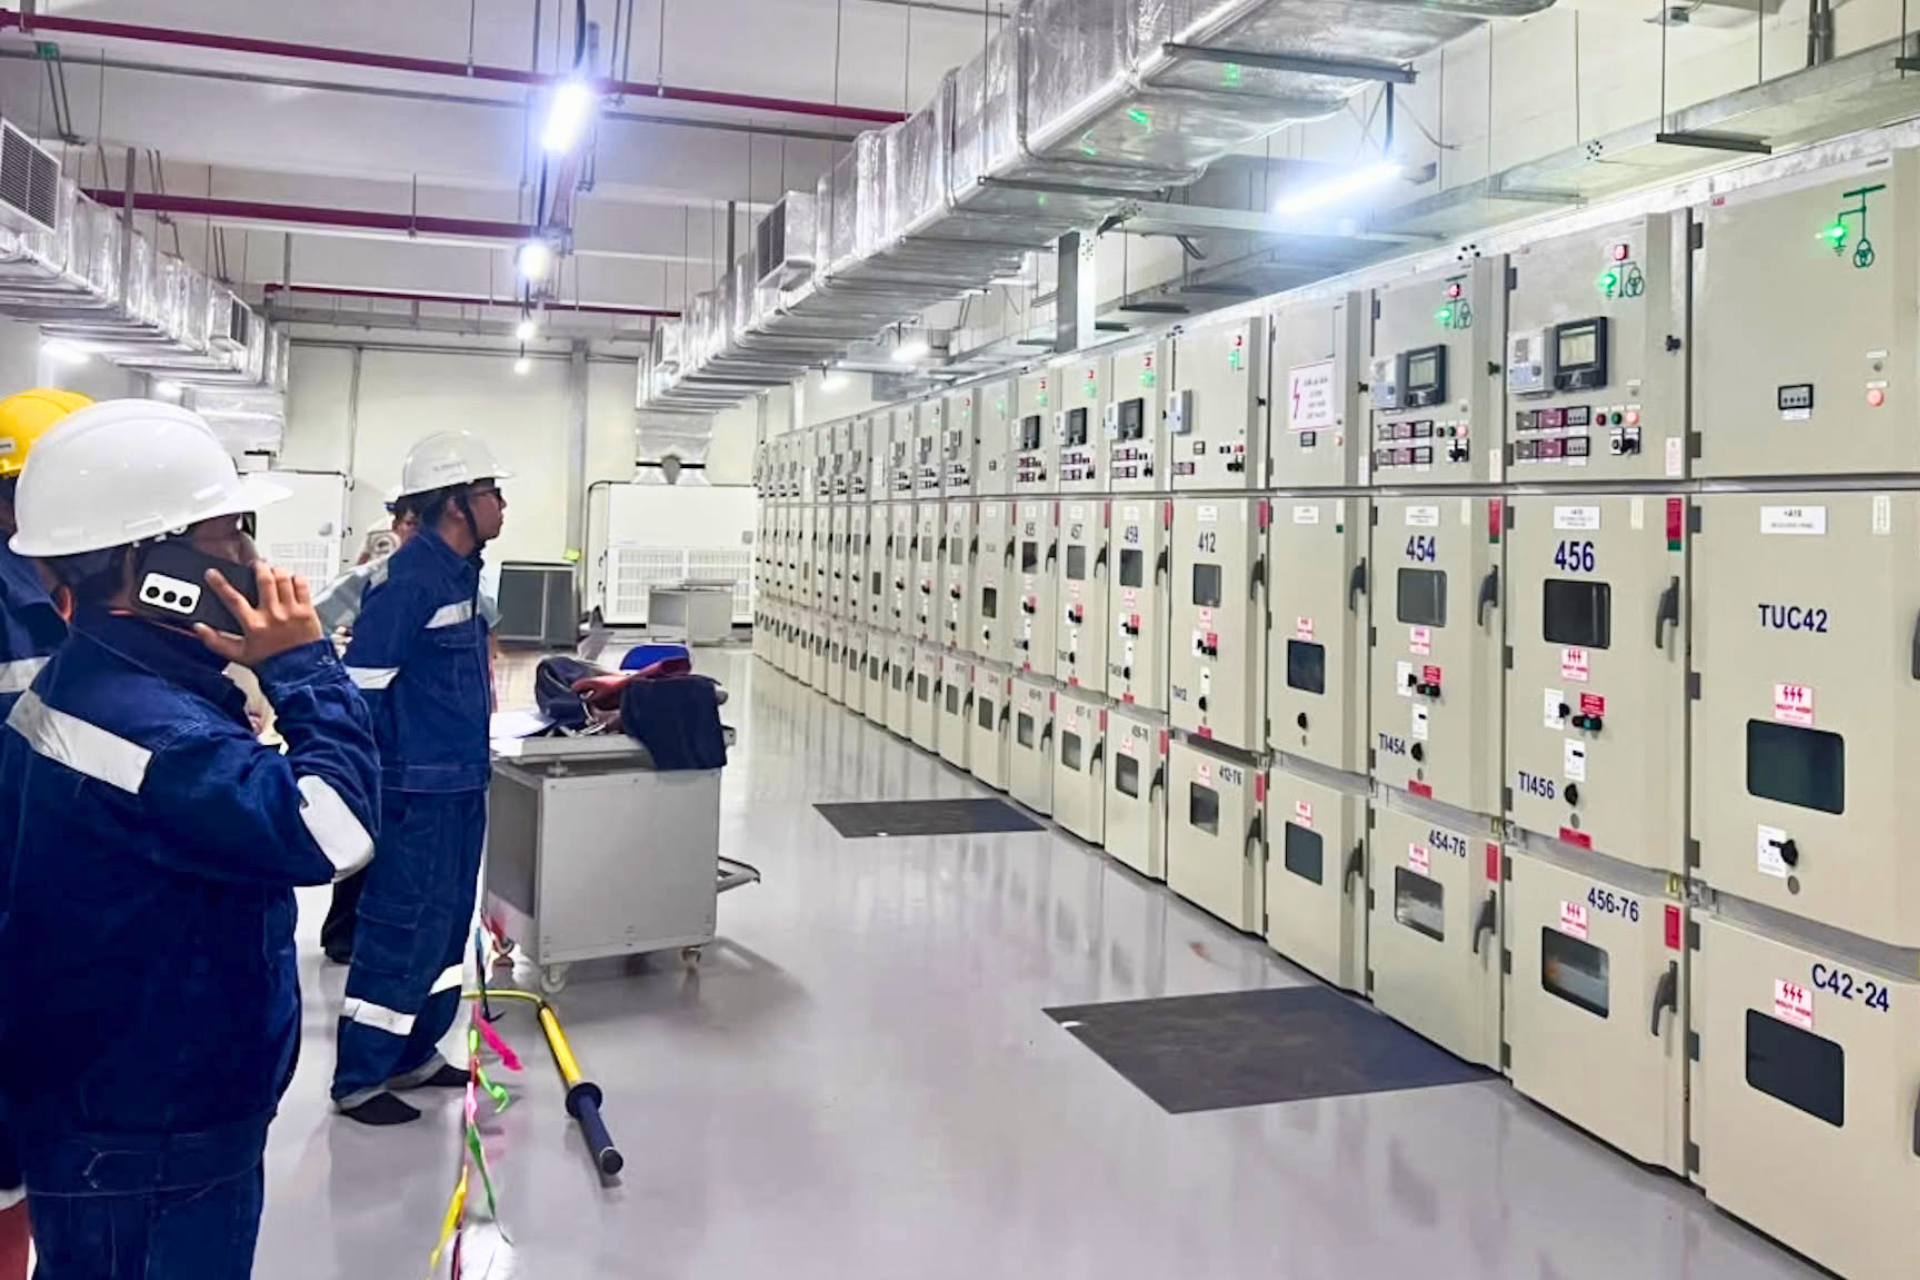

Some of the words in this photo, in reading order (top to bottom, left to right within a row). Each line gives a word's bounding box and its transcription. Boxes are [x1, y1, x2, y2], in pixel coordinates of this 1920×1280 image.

[1198, 532, 1216, 553] 412
[1406, 535, 1436, 562] 454
[1554, 540, 1595, 572] 456
[1758, 603, 1828, 633] TUC42
[1379, 733, 1406, 756] TI454
[1518, 771, 1555, 799] TI456
[1429, 829, 1466, 858] 454-76
[1587, 886, 1639, 922] 456-76
[1812, 963, 1889, 1012] C42-24
